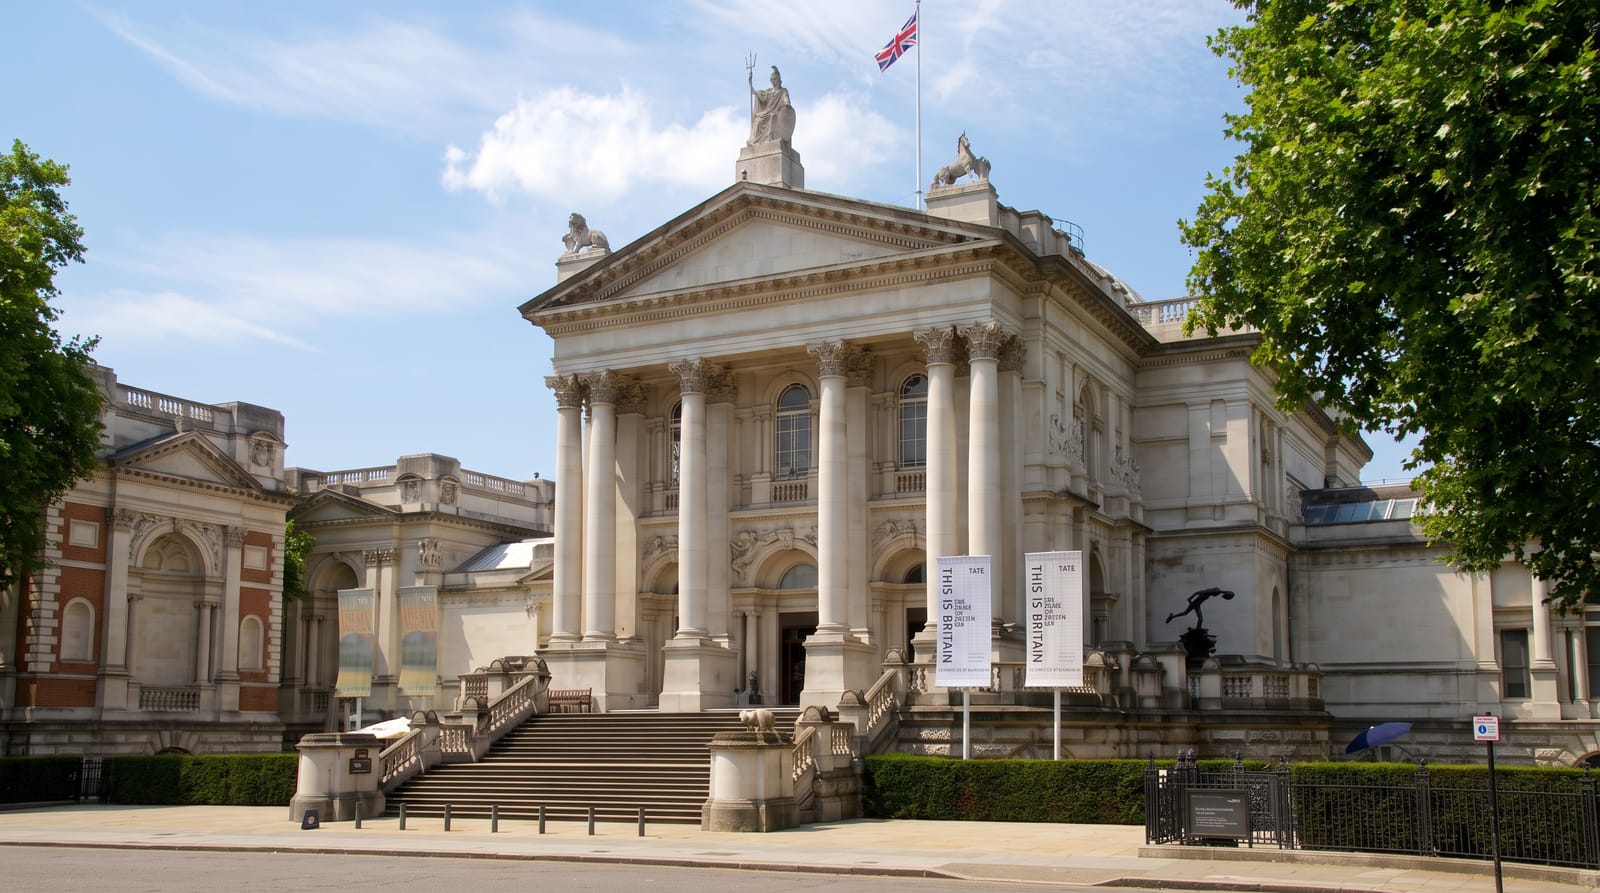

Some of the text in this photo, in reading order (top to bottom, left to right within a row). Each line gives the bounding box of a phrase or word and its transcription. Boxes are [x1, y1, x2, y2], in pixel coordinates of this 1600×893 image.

[942, 568, 953, 663] THIS IS BRITAIN
[1032, 565, 1043, 662] THIS IS BRITAIN
